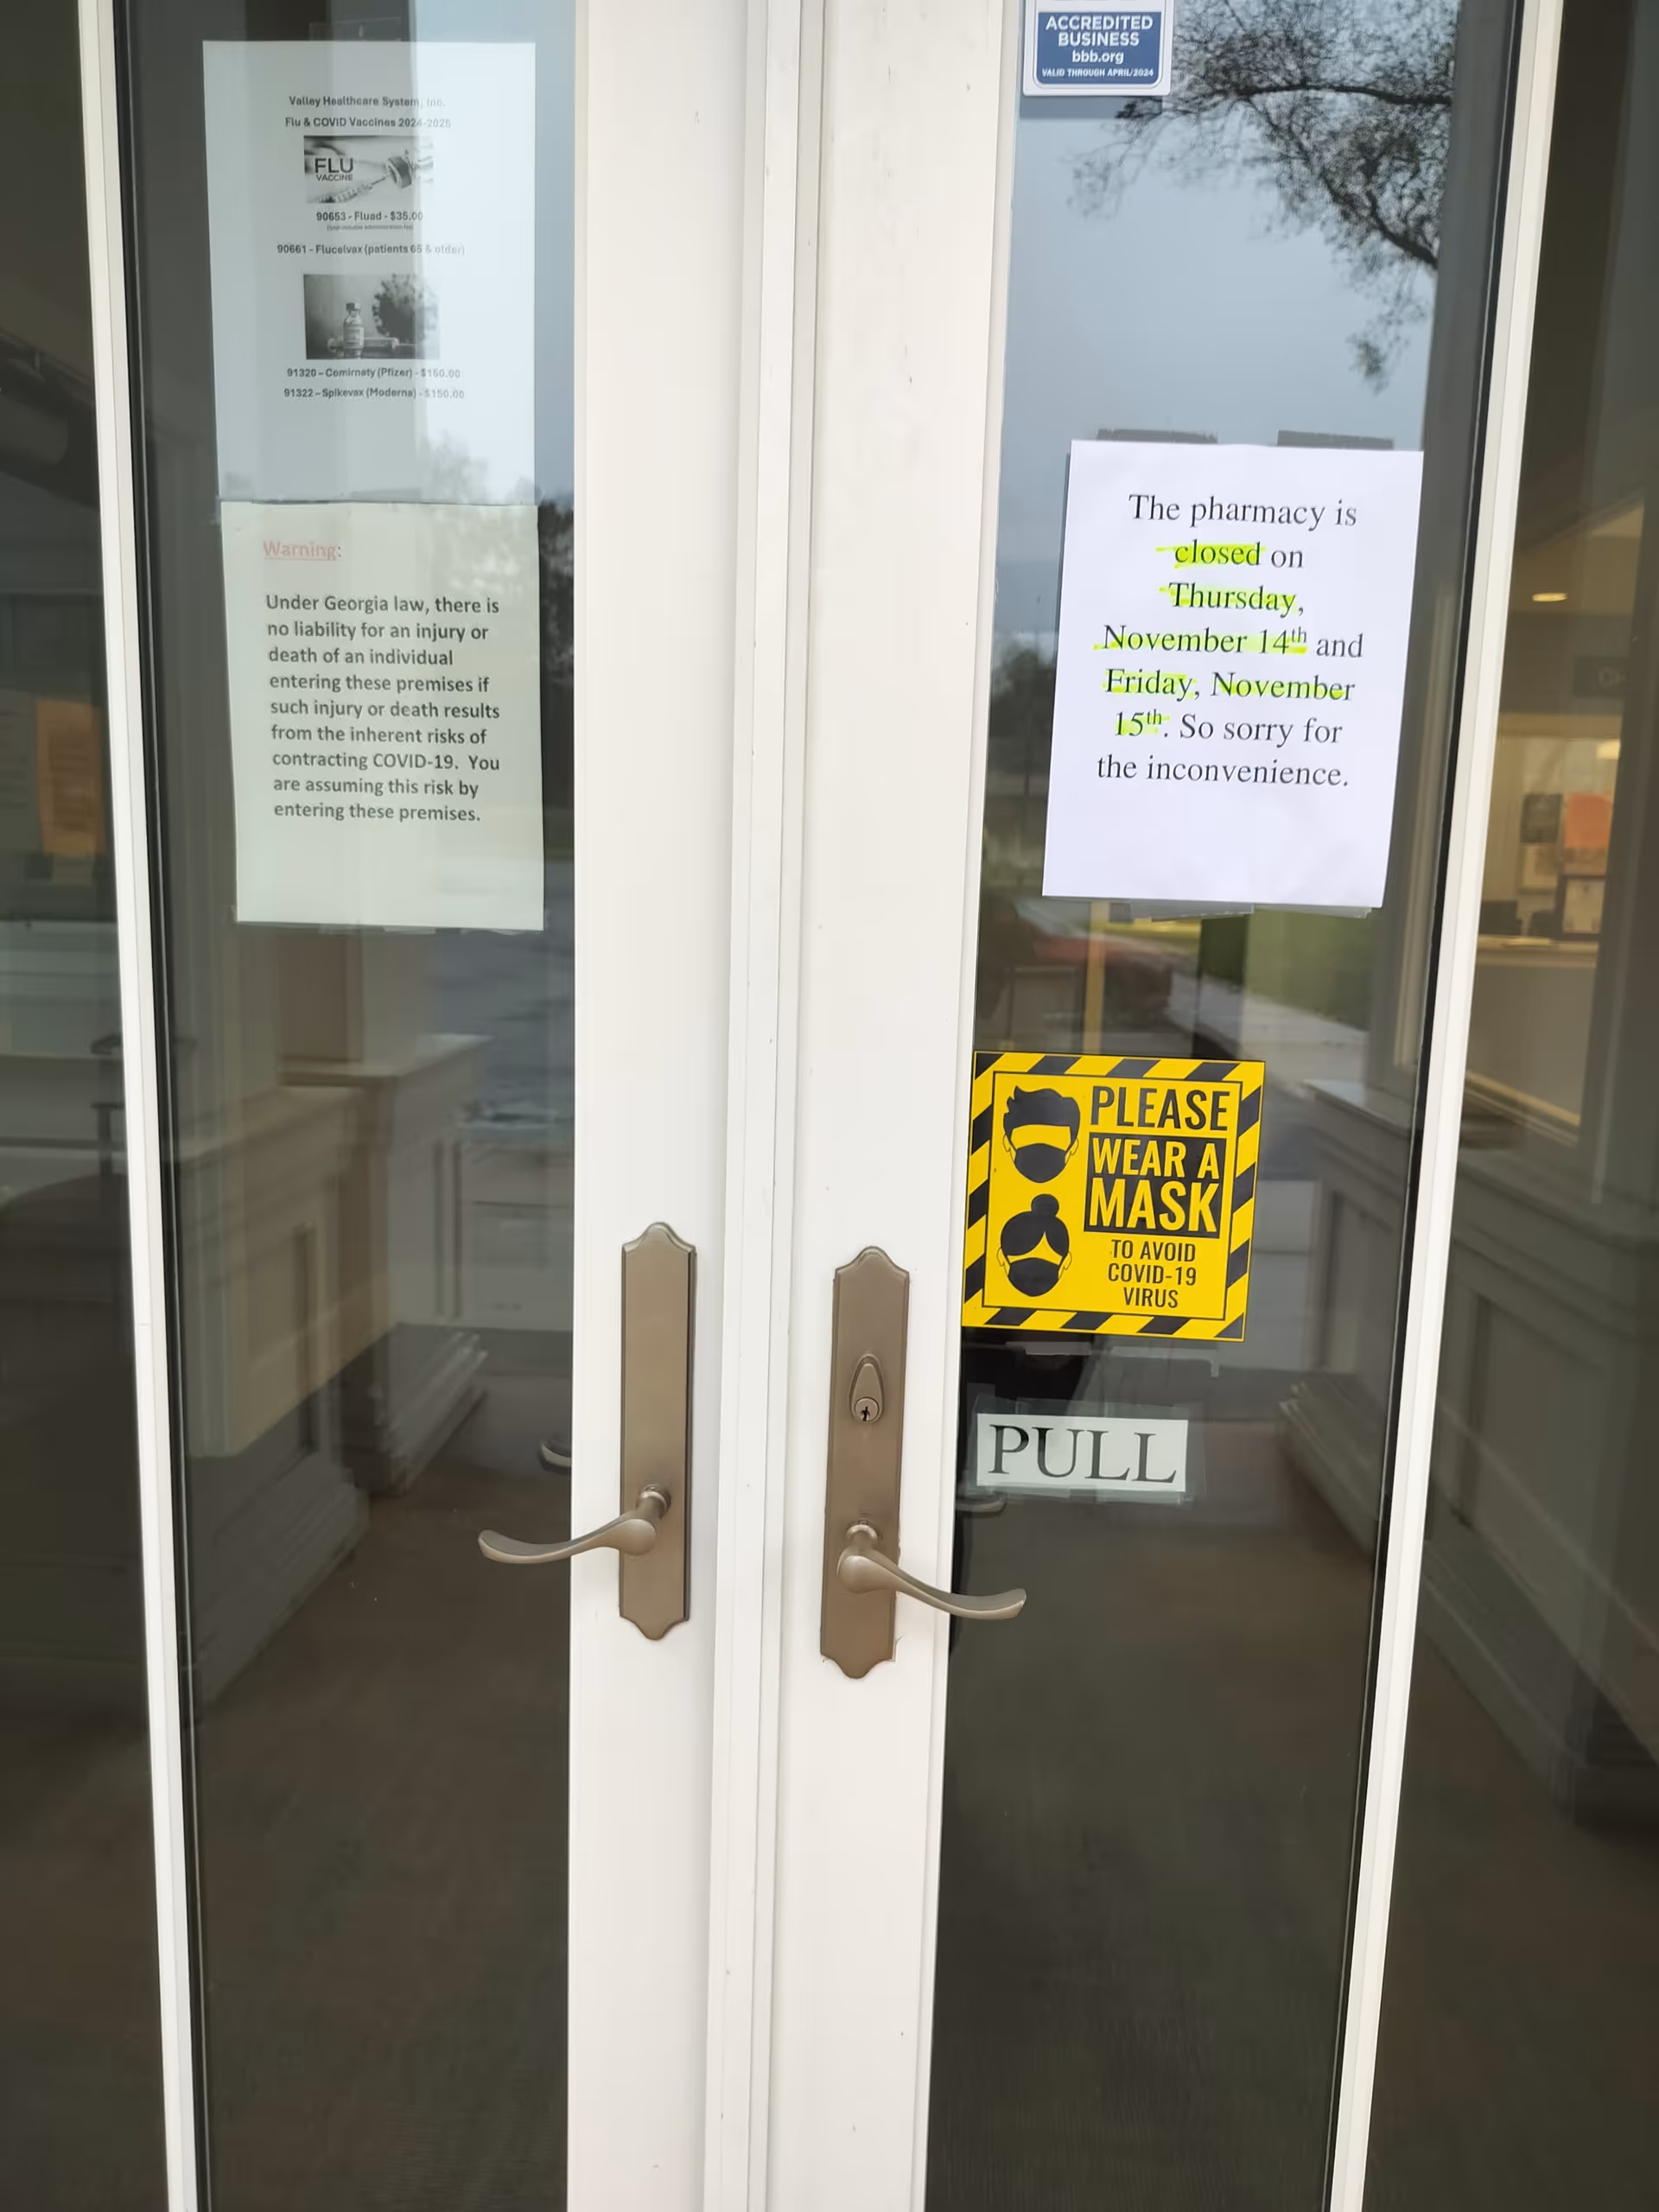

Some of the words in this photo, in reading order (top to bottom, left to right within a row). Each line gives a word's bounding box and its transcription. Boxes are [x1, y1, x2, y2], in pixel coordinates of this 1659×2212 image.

[1046, 15, 1153, 30] ACCREDITED
[1058, 31, 1140, 47] BUSINESS
[1072, 49, 1124, 64] bbb.org
[1042, 68, 1065, 77] VALID
[1067, 68, 1105, 77] THROUGH
[1108, 68, 1154, 77] APRIL/2024
[289, 96, 321, 108] Valley
[323, 96, 378, 106] Healthcare
[285, 118, 301, 127] Flu
[303, 118, 311, 127] &
[313, 118, 346, 127] COVID
[349, 118, 396, 128] Vaccines
[315, 157, 353, 173] FLU
[316, 213, 346, 222] 90653
[354, 212, 382, 221] Fluad
[391, 211, 423, 222] $35.00
[276, 245, 307, 254] 90661
[315, 244, 363, 254] Flucelvax
[365, 244, 409, 256] (patients
[287, 368, 317, 378] 91320
[325, 368, 375, 378] Comirnaty
[377, 368, 413, 378] (Pfizer)
[283, 389, 314, 397] 91322
[321, 388, 364, 399] Spikevax
[366, 388, 416, 399] (Moderna)
[1128, 493, 1180, 520] The
[1190, 494, 1325, 531] pharmacy
[1335, 499, 1357, 526] is
[263, 540, 341, 561] Warning:
[1174, 538, 1261, 565] closed
[1271, 549, 1303, 569] on
[266, 594, 319, 611] Under
[324, 595, 388, 614] Georgia
[394, 595, 430, 614] law,
[435, 597, 481, 613] there
[486, 598, 499, 613] is
[1169, 582, 1304, 619] Thursday,
[267, 623, 289, 636] no
[294, 621, 356, 640] liability
[361, 623, 385, 638] for
[390, 626, 410, 638] an
[416, 623, 466, 642] injury
[471, 626, 488, 639] or
[1103, 625, 1247, 654] November
[1259, 626, 1307, 655] 14th
[1316, 633, 1363, 658] and
[269, 647, 317, 663] death
[323, 648, 340, 664] of
[345, 652, 365, 664] an
[370, 649, 454, 665] individual
[270, 674, 341, 692] entering
[346, 675, 391, 690] these
[397, 677, 473, 693] premises
[478, 677, 489, 692] if
[1105, 668, 1200, 702] Friday,
[1211, 671, 1355, 702] November
[270, 699, 308, 715] such
[314, 700, 363, 718] injury
[367, 703, 385, 716] or
[390, 702, 439, 717] death
[444, 702, 500, 719] results
[271, 725, 312, 740] from
[317, 726, 346, 741] the
[350, 727, 422, 743] inherent
[428, 728, 465, 744] risks
[470, 728, 486, 744] of
[1115, 709, 1168, 737] 15th.
[1180, 713, 1213, 739] So
[1224, 721, 1294, 748] sorry
[1303, 717, 1343, 744] for
[273, 753, 367, 770] contracting
[373, 753, 459, 770] COVID-19.
[468, 755, 500, 771] You
[1098, 753, 1136, 779] the
[1147, 755, 1348, 787] inconvenience.
[273, 779, 300, 791] are
[306, 779, 384, 797] assuming
[388, 779, 418, 794] this
[424, 779, 454, 795] risk
[459, 780, 479, 799] by
[274, 803, 344, 820] entering
[349, 804, 394, 819] these
[399, 804, 480, 822] premises.
[1090, 1085, 1230, 1131] PLEASE
[1092, 1137, 1186, 1178] WEAR
[1198, 1142, 1219, 1179] A
[1089, 1177, 1220, 1232] MASK
[1111, 1239, 1134, 1259] TO
[1140, 1241, 1196, 1262] AVOID
[1108, 1263, 1196, 1286] COVID-19
[1123, 1287, 1179, 1308] VIRUS
[988, 1424, 1177, 1483] PULL
